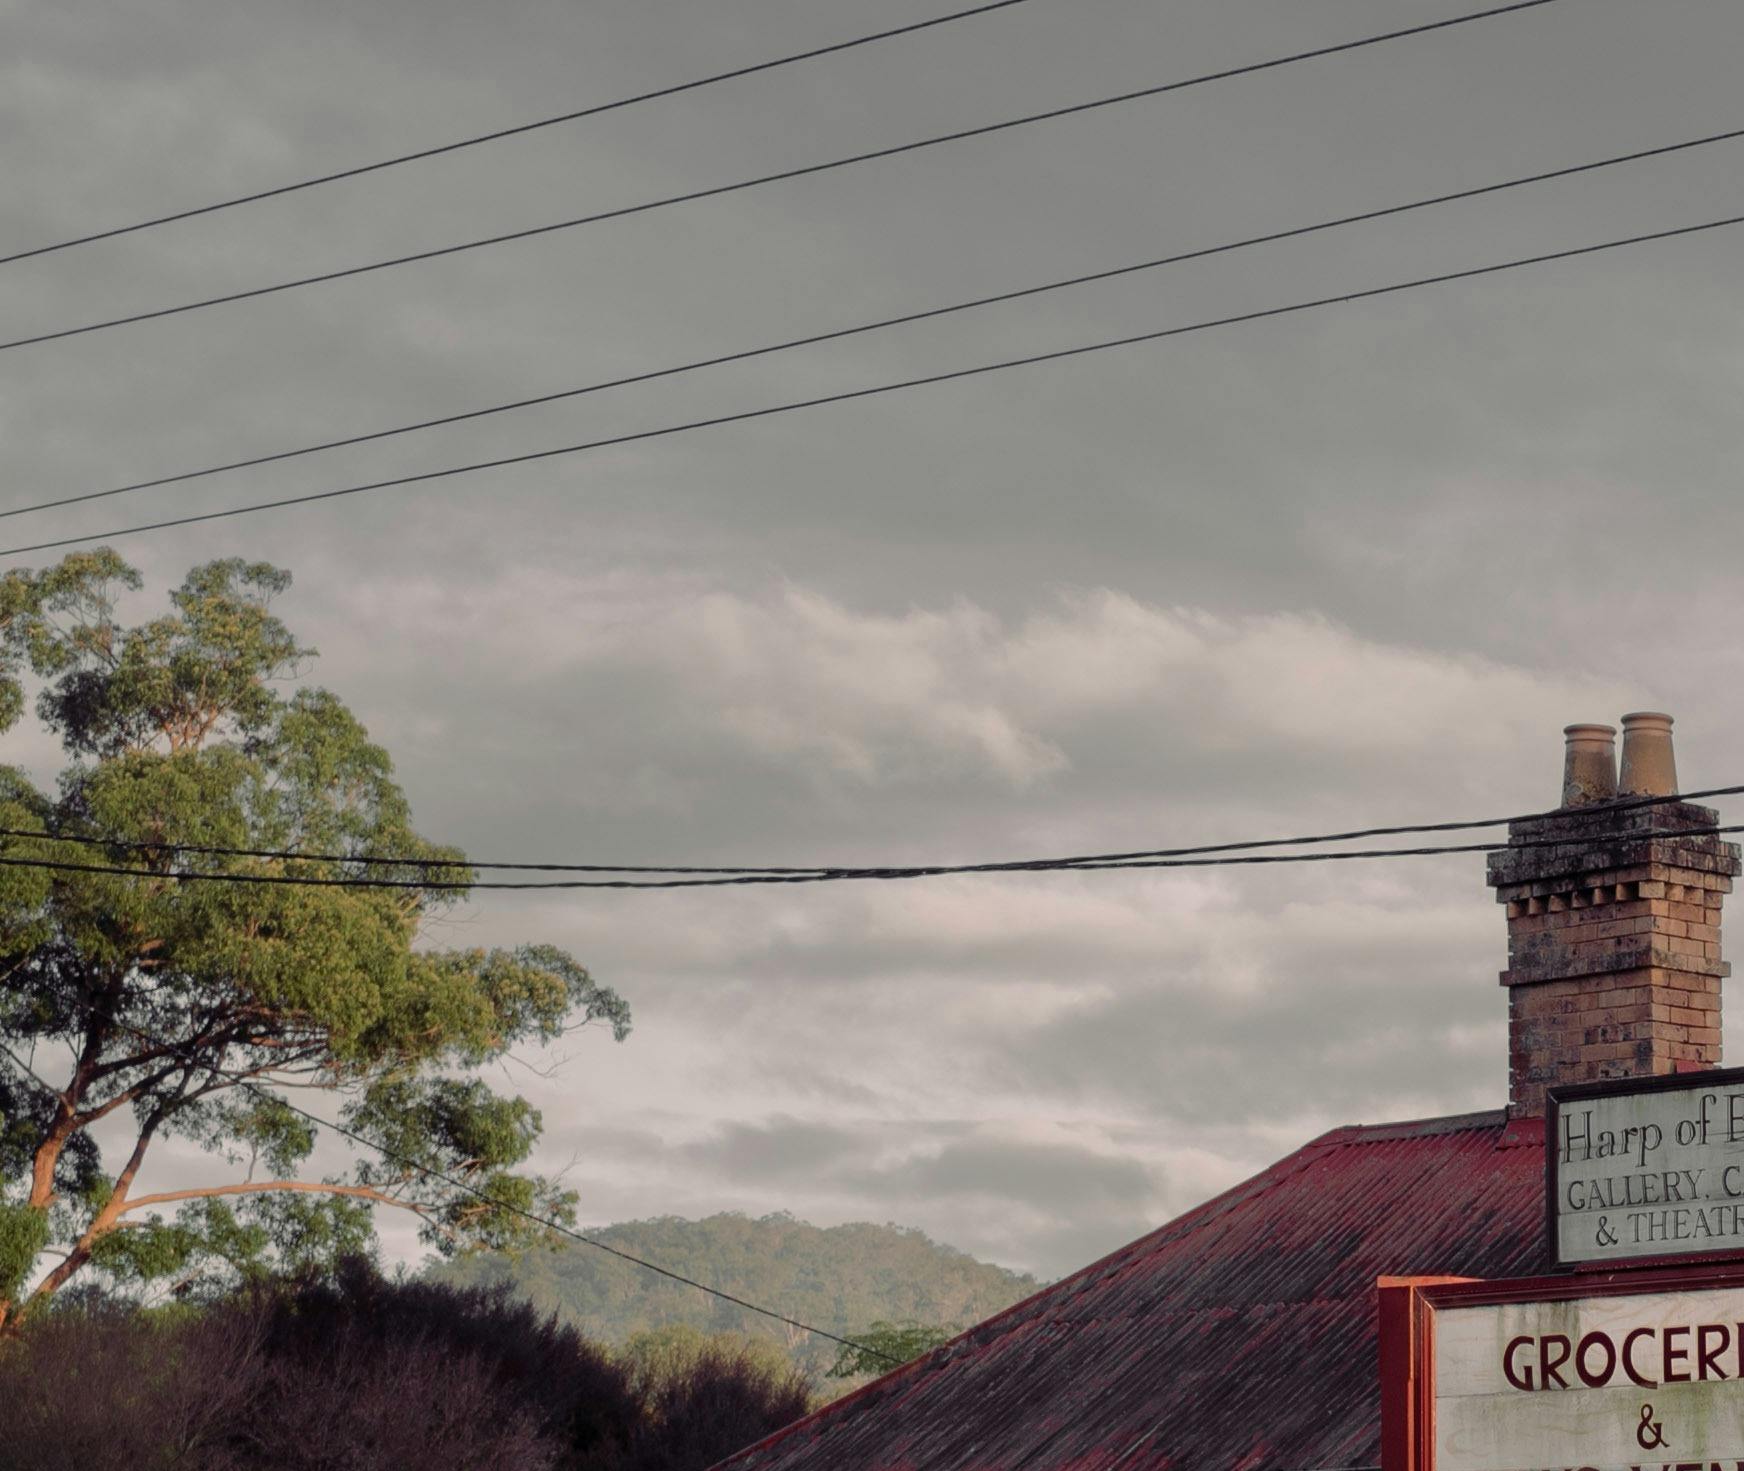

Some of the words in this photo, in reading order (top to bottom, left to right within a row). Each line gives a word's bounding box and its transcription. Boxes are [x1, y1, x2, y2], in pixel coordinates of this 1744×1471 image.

[1561, 1110, 1663, 1168] Harp
[1675, 1093, 1717, 1146] of
[1594, 1214, 1619, 1247] &
[1636, 1404, 1670, 1450] &
